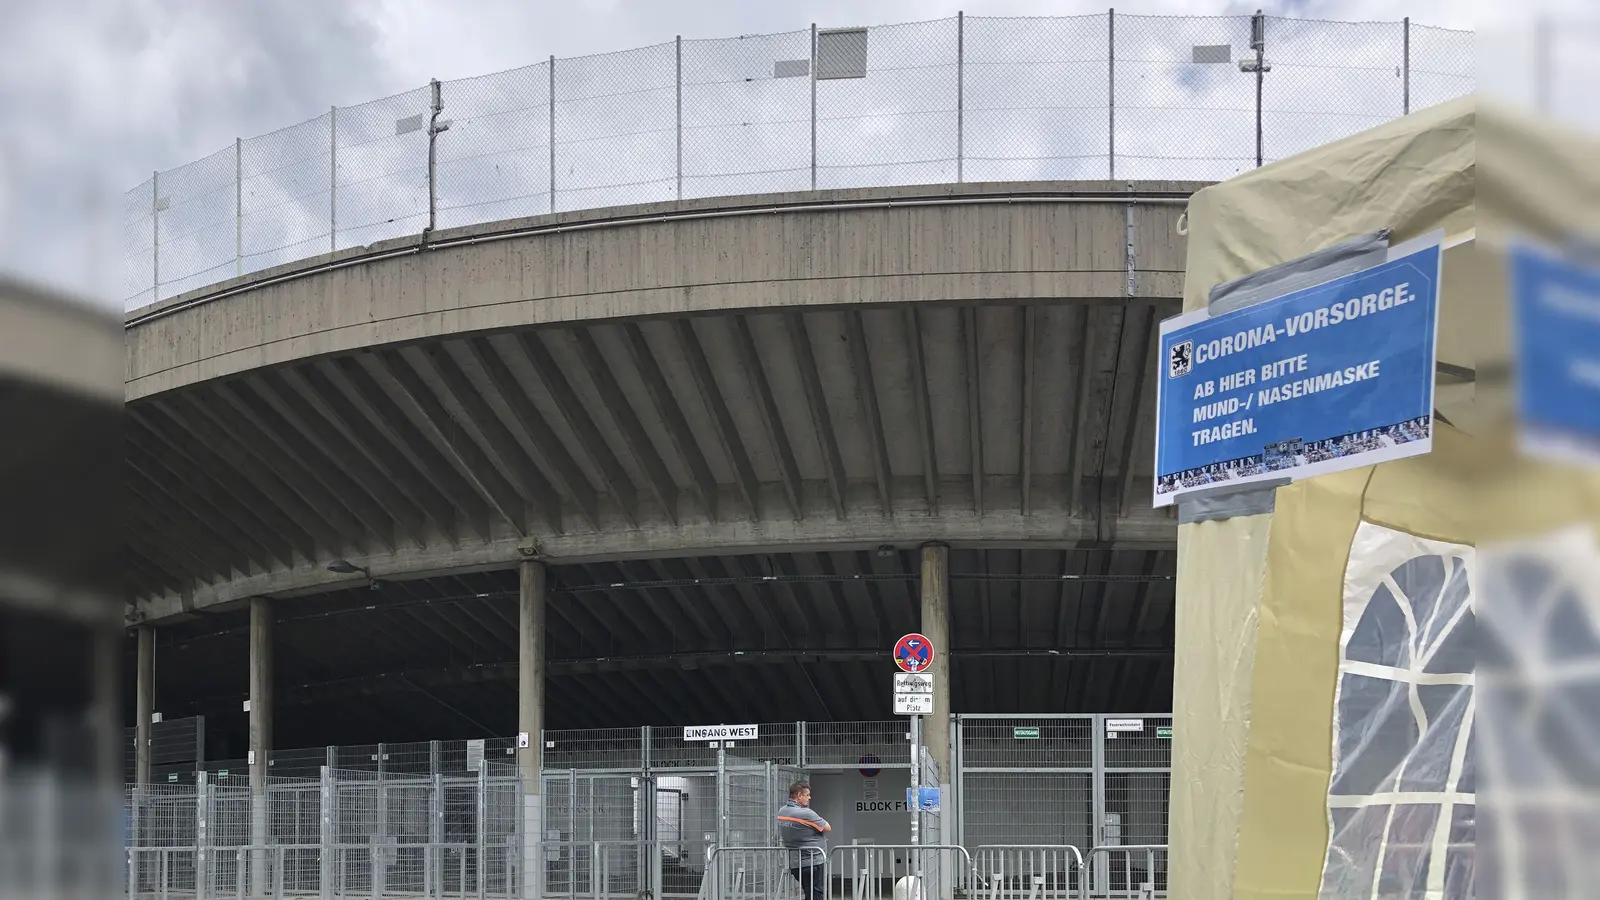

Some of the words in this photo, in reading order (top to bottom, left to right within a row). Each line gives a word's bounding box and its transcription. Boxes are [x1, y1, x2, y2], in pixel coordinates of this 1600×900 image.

[1195, 282, 1416, 364] CORONA-VORSORGE.
[1193, 380, 1215, 400] AB
[1219, 368, 1256, 393] HIER
[1261, 353, 1308, 381] BITTE
[1192, 393, 1254, 423] MUND-/
[1258, 360, 1380, 407] NASENMASKE
[1192, 418, 1258, 447] TRAGEN.
[1201, 455, 1256, 474] VEREIN
[729, 727, 756, 737] WEST
[856, 801, 892, 811] BLOCK
